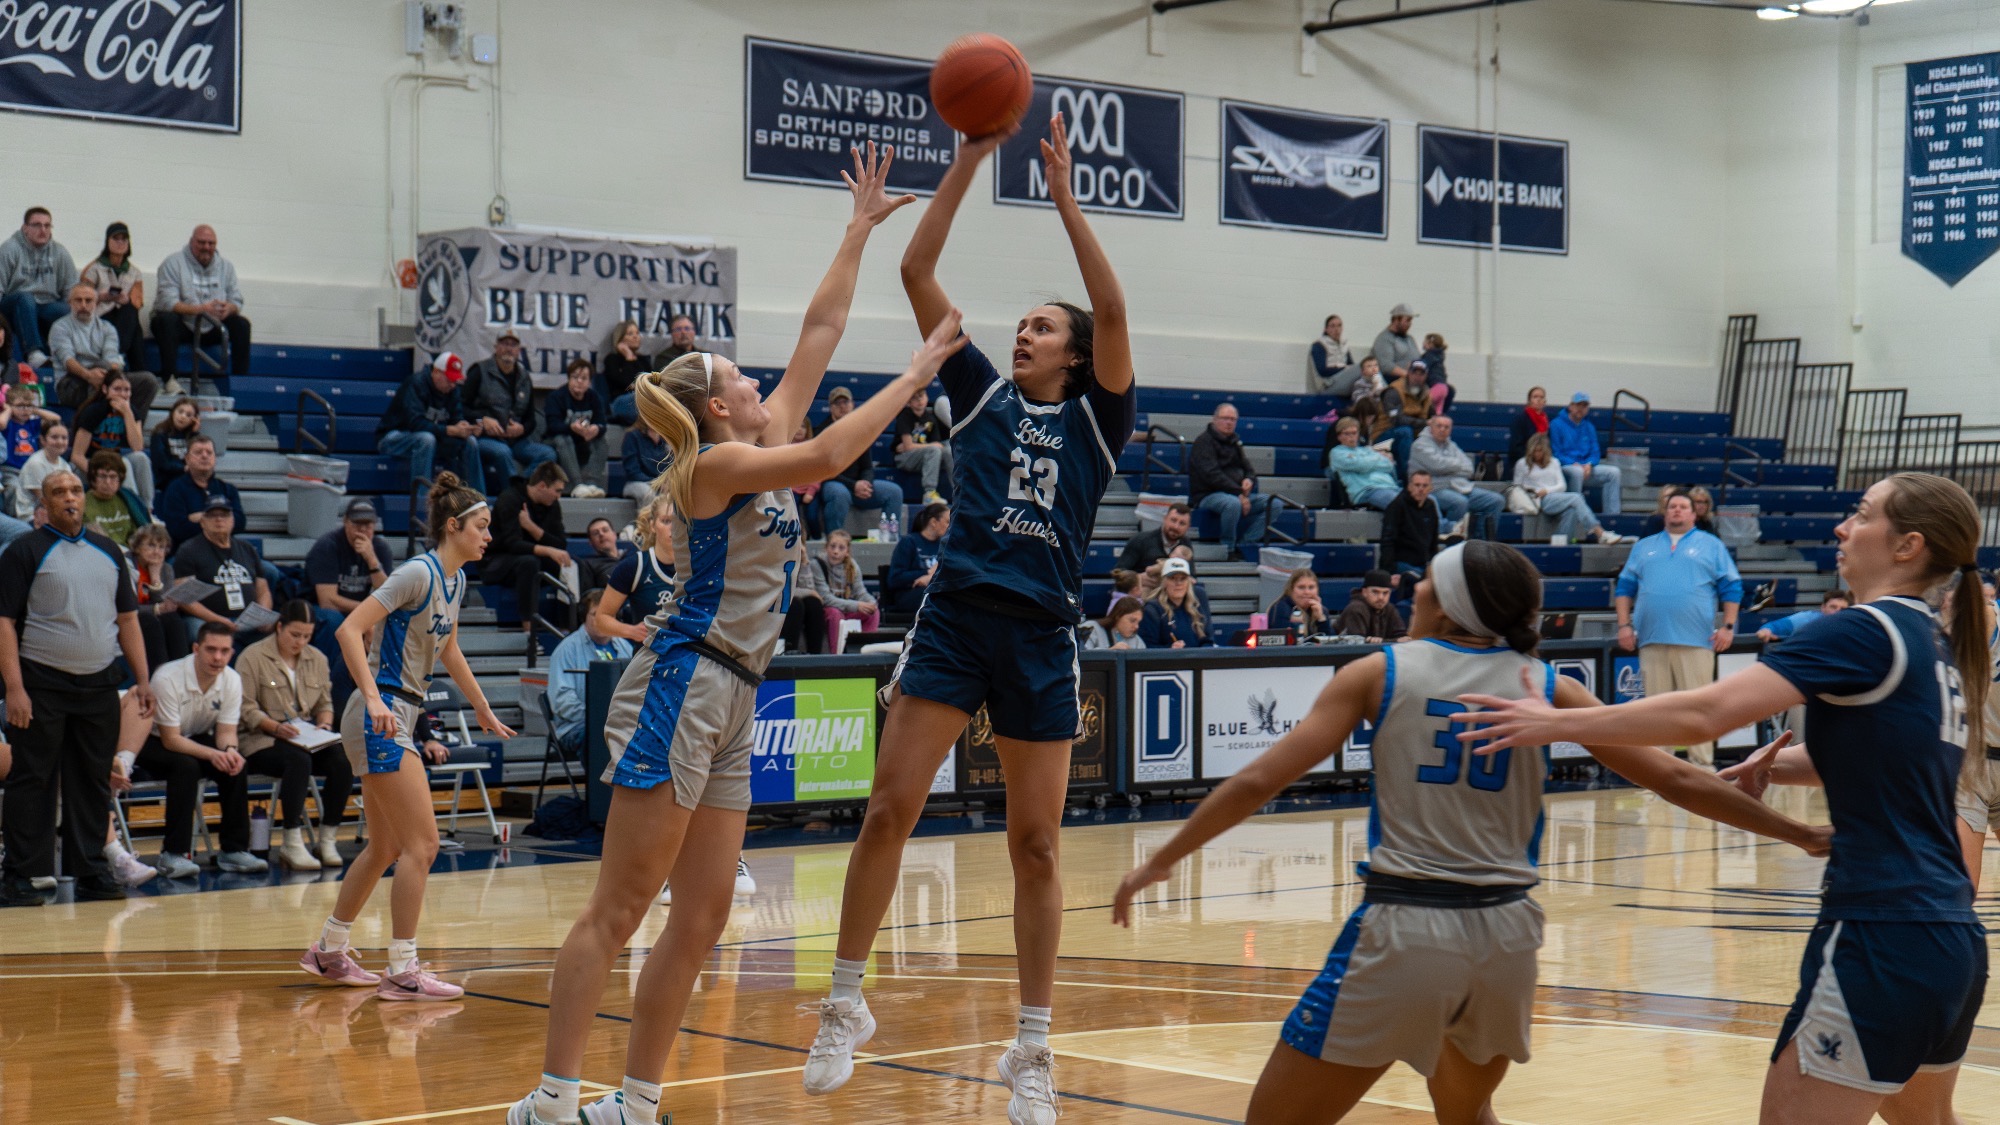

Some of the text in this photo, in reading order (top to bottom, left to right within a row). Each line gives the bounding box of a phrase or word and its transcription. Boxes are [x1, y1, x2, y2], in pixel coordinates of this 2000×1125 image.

[0, 0, 224, 91] oca-Cola
[782, 78, 928, 121] SANFORD
[1914, 75, 1999, 96] Golf Championships
[754, 128, 842, 153] SPORTS
[778, 114, 931, 145] ORTHOPEDICS
[1231, 145, 1315, 178] SAX
[1028, 157, 1146, 208] MDCO
[1453, 176, 1564, 209] CHOICE BANK
[1909, 174, 1937, 187] Tennis
[499, 244, 720, 288] SUPPORTING
[485, 287, 591, 333] BLUE
[1013, 418, 1064, 450] Blue
[1007, 446, 1059, 511] 23
[753, 716, 866, 757] UTORAMA
[1207, 722, 1248, 736] BLUE
[1416, 697, 1513, 793] 30
[761, 754, 848, 772] AUTO
